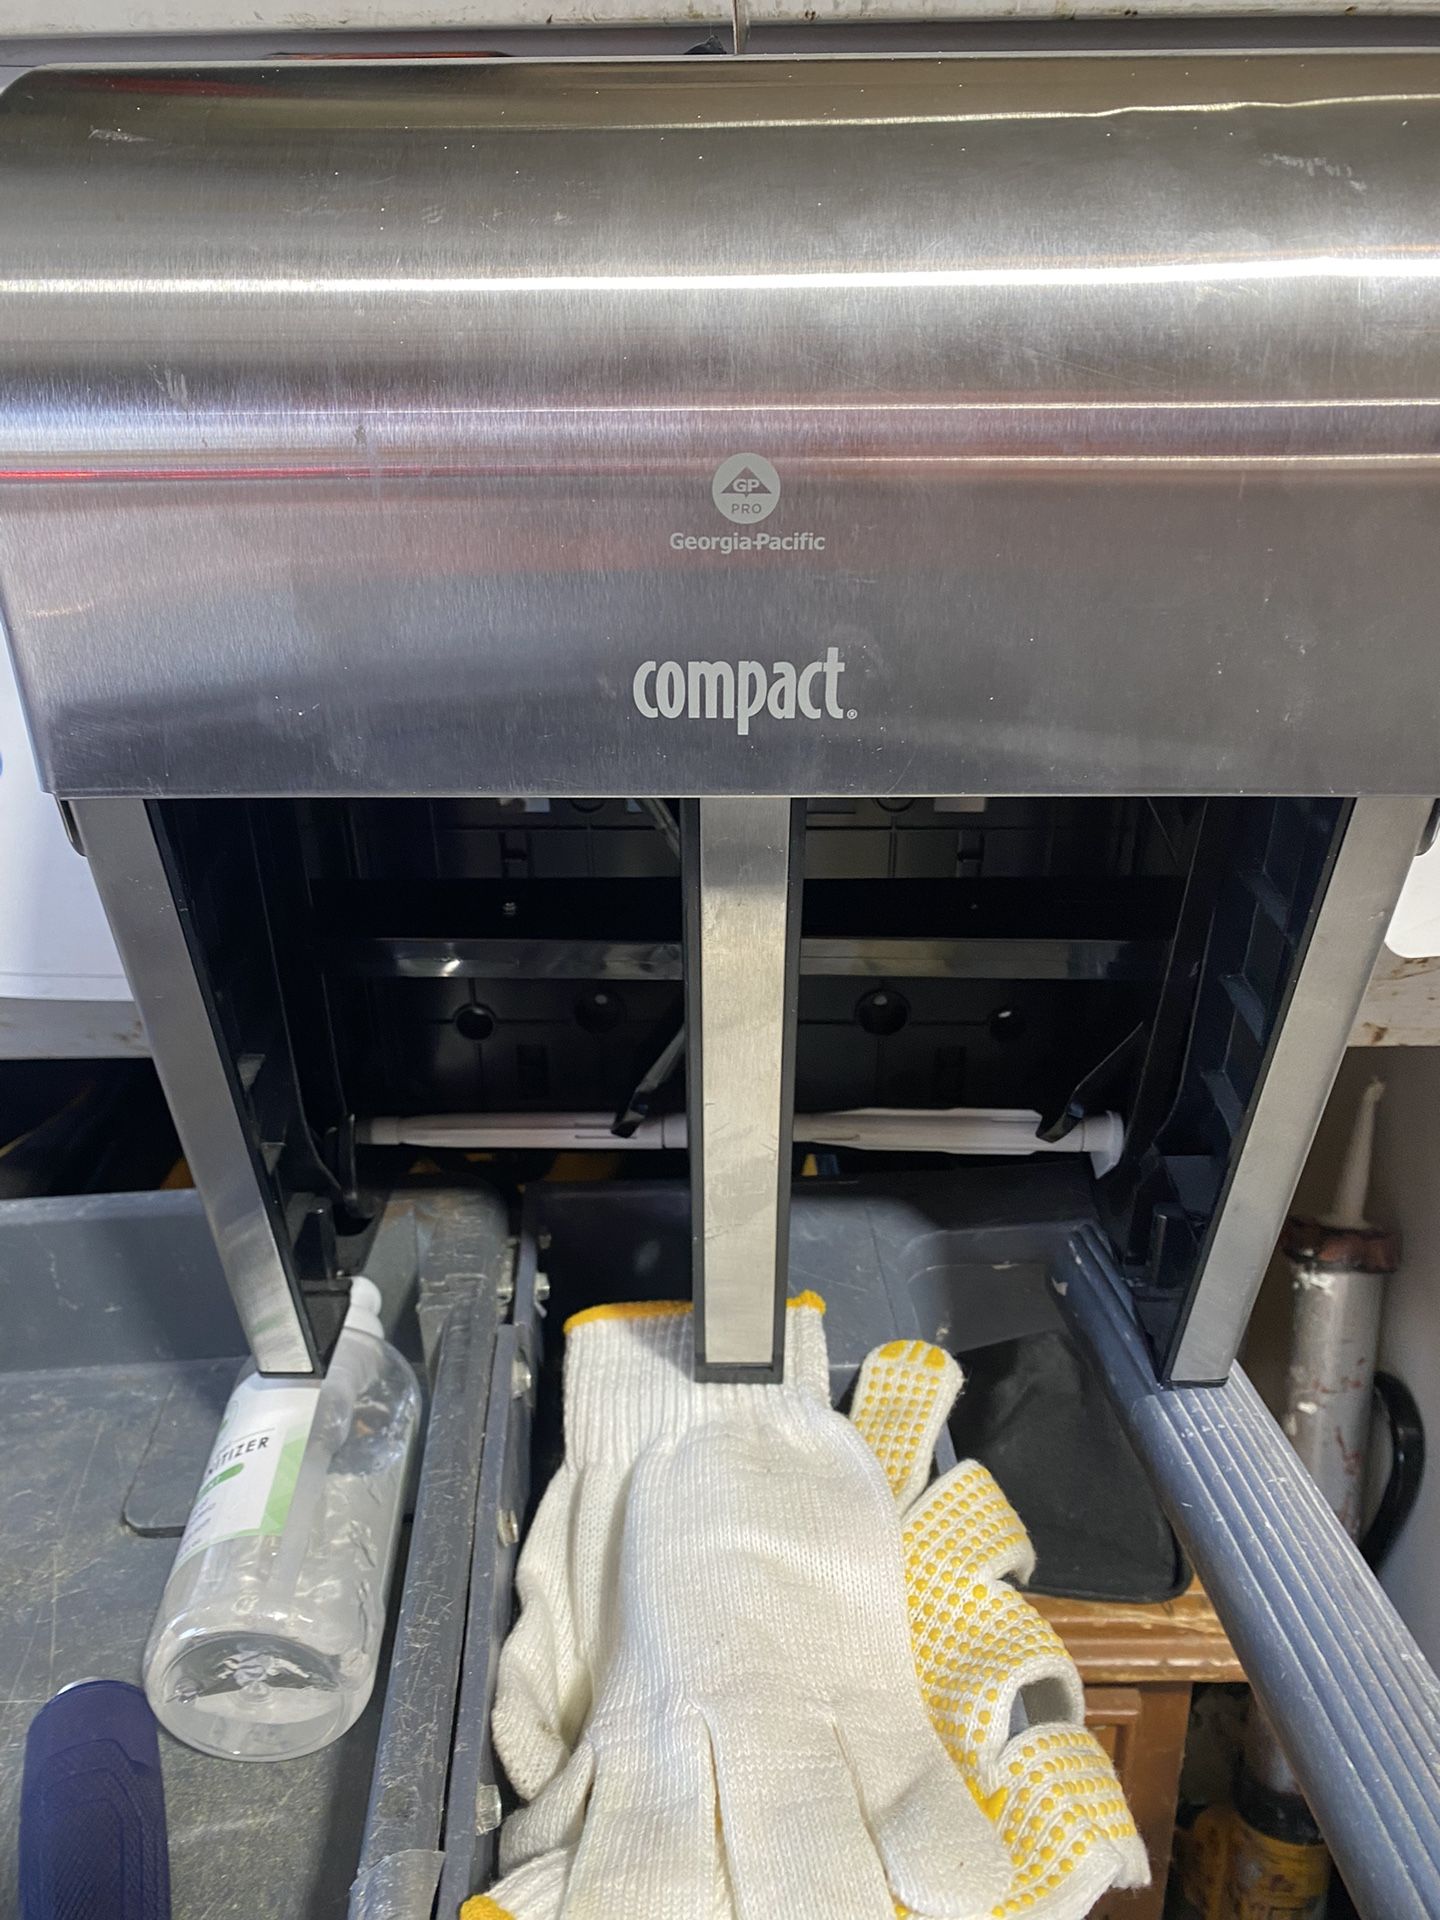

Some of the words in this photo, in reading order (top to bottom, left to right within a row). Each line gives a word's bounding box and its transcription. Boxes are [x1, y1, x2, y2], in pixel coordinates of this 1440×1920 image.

[732, 478, 760, 493] GP
[731, 503, 762, 514] PRO
[670, 532, 826, 554] Georgia-Pacific
